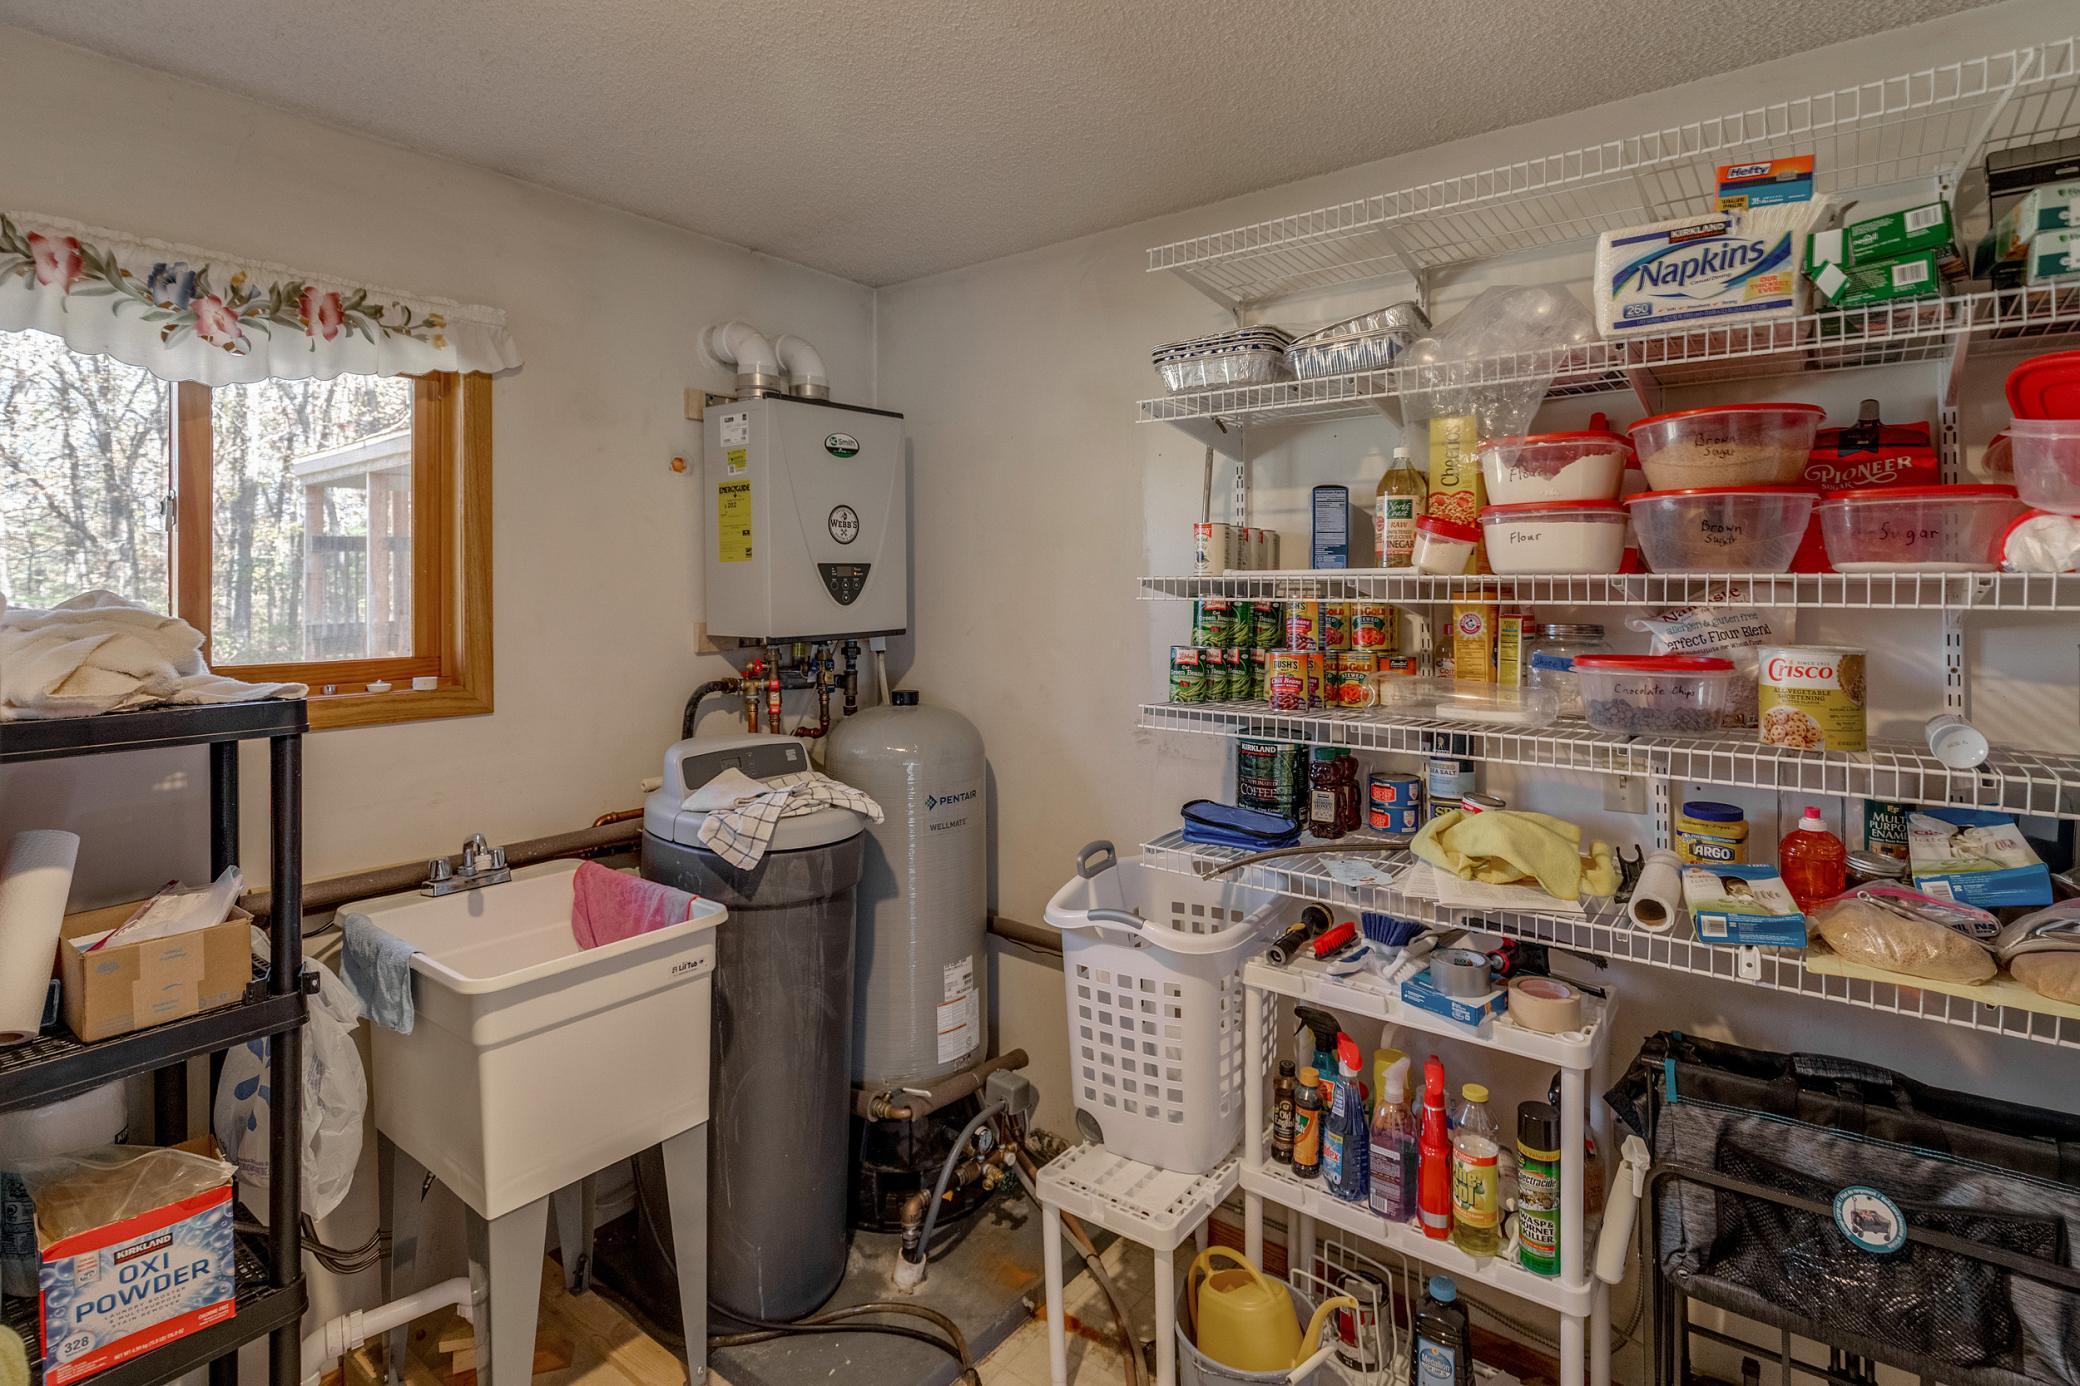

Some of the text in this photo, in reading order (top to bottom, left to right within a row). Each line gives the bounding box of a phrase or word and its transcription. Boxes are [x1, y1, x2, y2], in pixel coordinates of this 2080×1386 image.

[1731, 166, 1767, 176] Hefty
[1671, 223, 1725, 238] KIRKLAND
[1637, 240, 1765, 292] Napkins
[1626, 303, 1648, 315] 260
[1695, 433, 1737, 447] Brown
[1703, 447, 1736, 458] Sugar
[1808, 455, 1912, 484] PIONEER
[830, 519, 858, 528] WEBB'S
[1702, 519, 1743, 535] Brown
[1510, 532, 1542, 544] Flour
[1704, 534, 1738, 547] Sugar
[1879, 521, 1940, 545] Sugar
[1667, 623, 1772, 651] erfect Flour Blend
[1274, 660, 1298, 670] BUSH'S
[1768, 657, 1833, 682] Crisco
[1241, 743, 1277, 753] KIRKLAND
[939, 790, 977, 805] PENTAIR
[1240, 783, 1278, 797] COFFEE
[929, 818, 967, 831] WELLMATE
[1694, 845, 1731, 860] ARGO
[1279, 1111, 1291, 1120] Old
[1519, 1172, 1557, 1188] pectracide
[1520, 1211, 1547, 1228] WASP
[1523, 1228, 1554, 1243] KILLER
[116, 1235, 172, 1260] KIRKLAND
[119, 1252, 169, 1285] OXI
[76, 1258, 211, 1324] POWDER
[64, 1336, 89, 1354] 328
